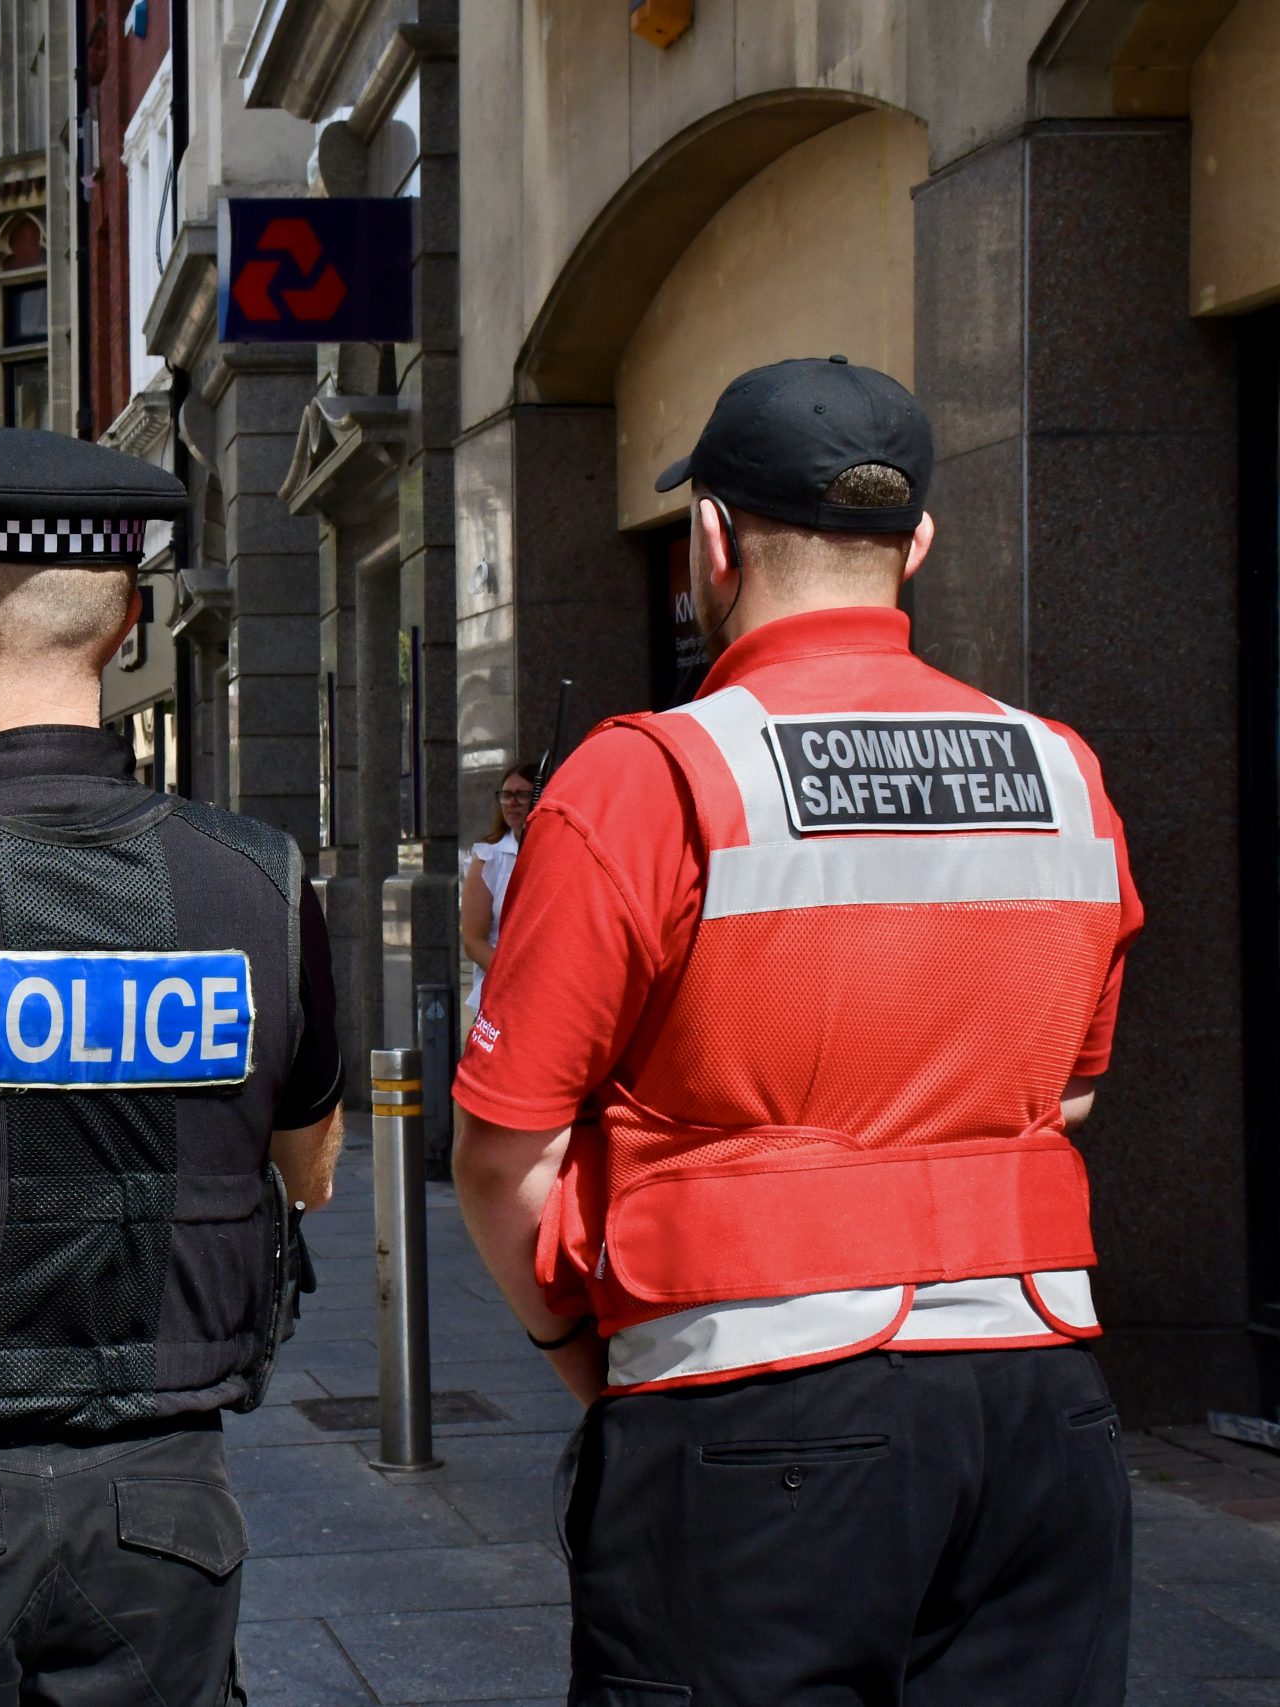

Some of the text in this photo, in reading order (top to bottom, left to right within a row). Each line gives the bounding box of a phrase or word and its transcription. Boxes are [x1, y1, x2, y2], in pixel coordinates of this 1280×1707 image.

[675, 592, 694, 624] KN
[801, 729, 1016, 770] COMMUNITY
[800, 773, 1045, 815] SAFETY TEAM
